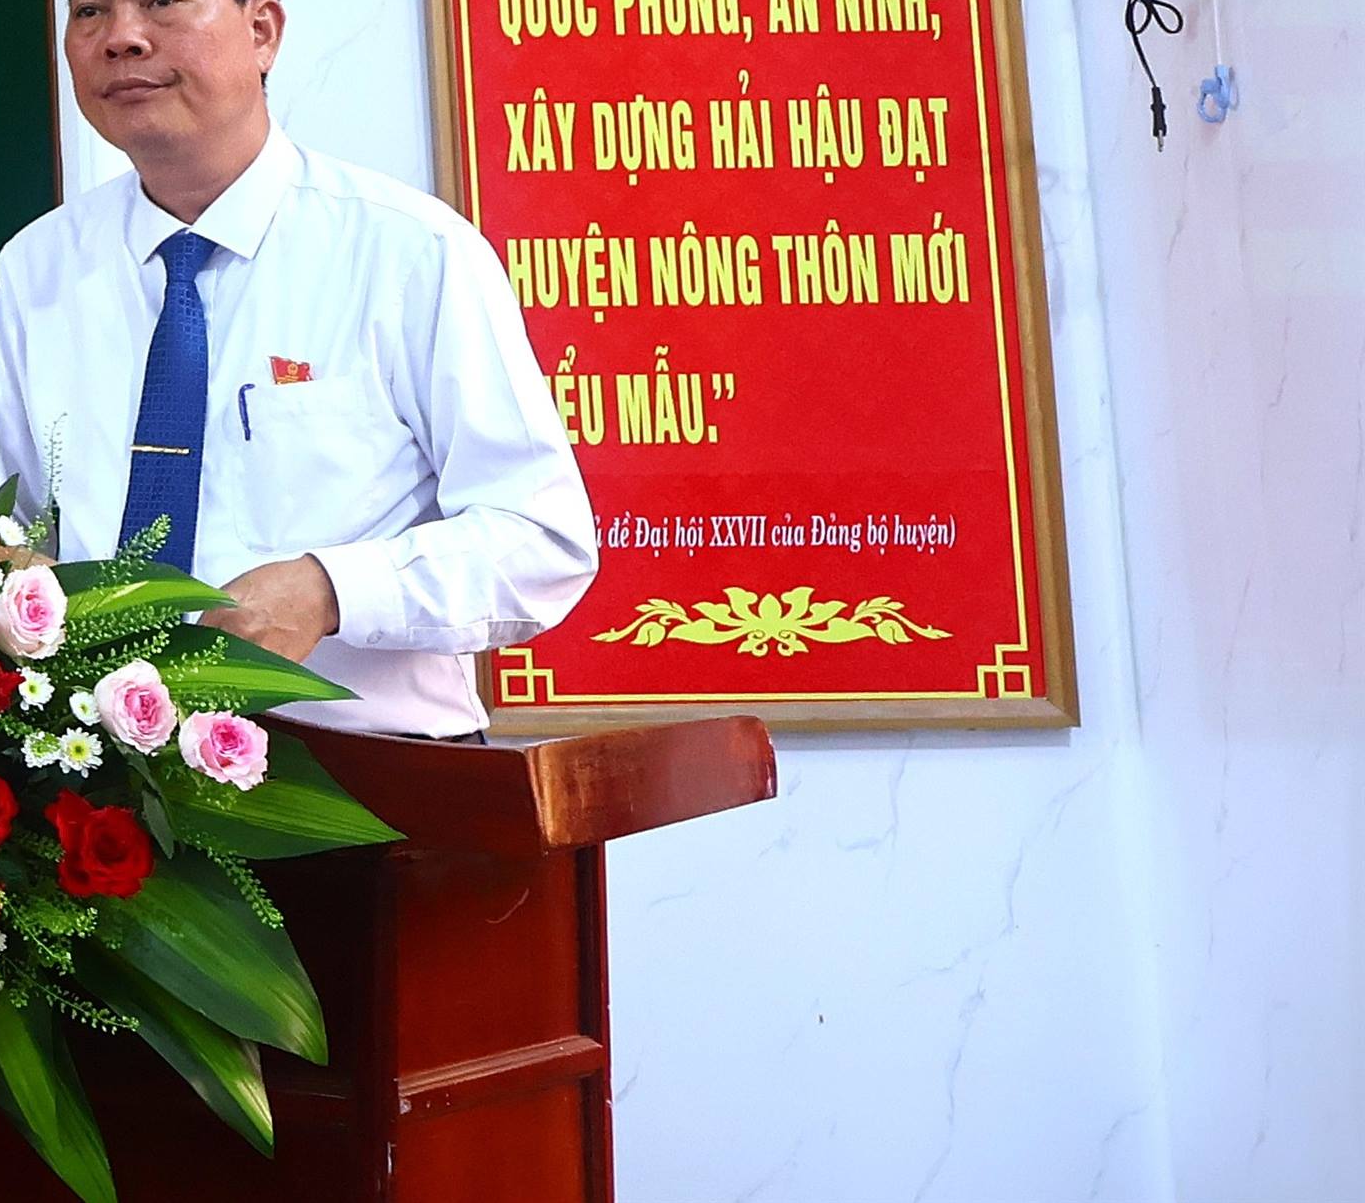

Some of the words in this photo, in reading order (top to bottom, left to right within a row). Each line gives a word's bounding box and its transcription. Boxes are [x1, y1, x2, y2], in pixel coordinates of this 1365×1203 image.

[503, 88, 576, 172] XÂY
[592, 94, 696, 186] DỰNG
[709, 70, 774, 169] HẢI
[788, 84, 863, 184] HẬU
[879, 97, 948, 182] ĐẠT
[506, 223, 636, 323] HUYỆN
[649, 222, 762, 307] NÔNG
[772, 220, 879, 305] THÔN
[890, 212, 970, 303] MỚI
[543, 345, 606, 446] ỂU
[608, 511, 631, 548] đề
[635, 517, 668, 557] Đại
[675, 516, 704, 557] hội
[710, 516, 766, 547] XXVII
[771, 513, 805, 547] của
[811, 513, 861, 553] Đảng
[867, 514, 888, 554] bộ
[894, 514, 955, 554] huyện)
